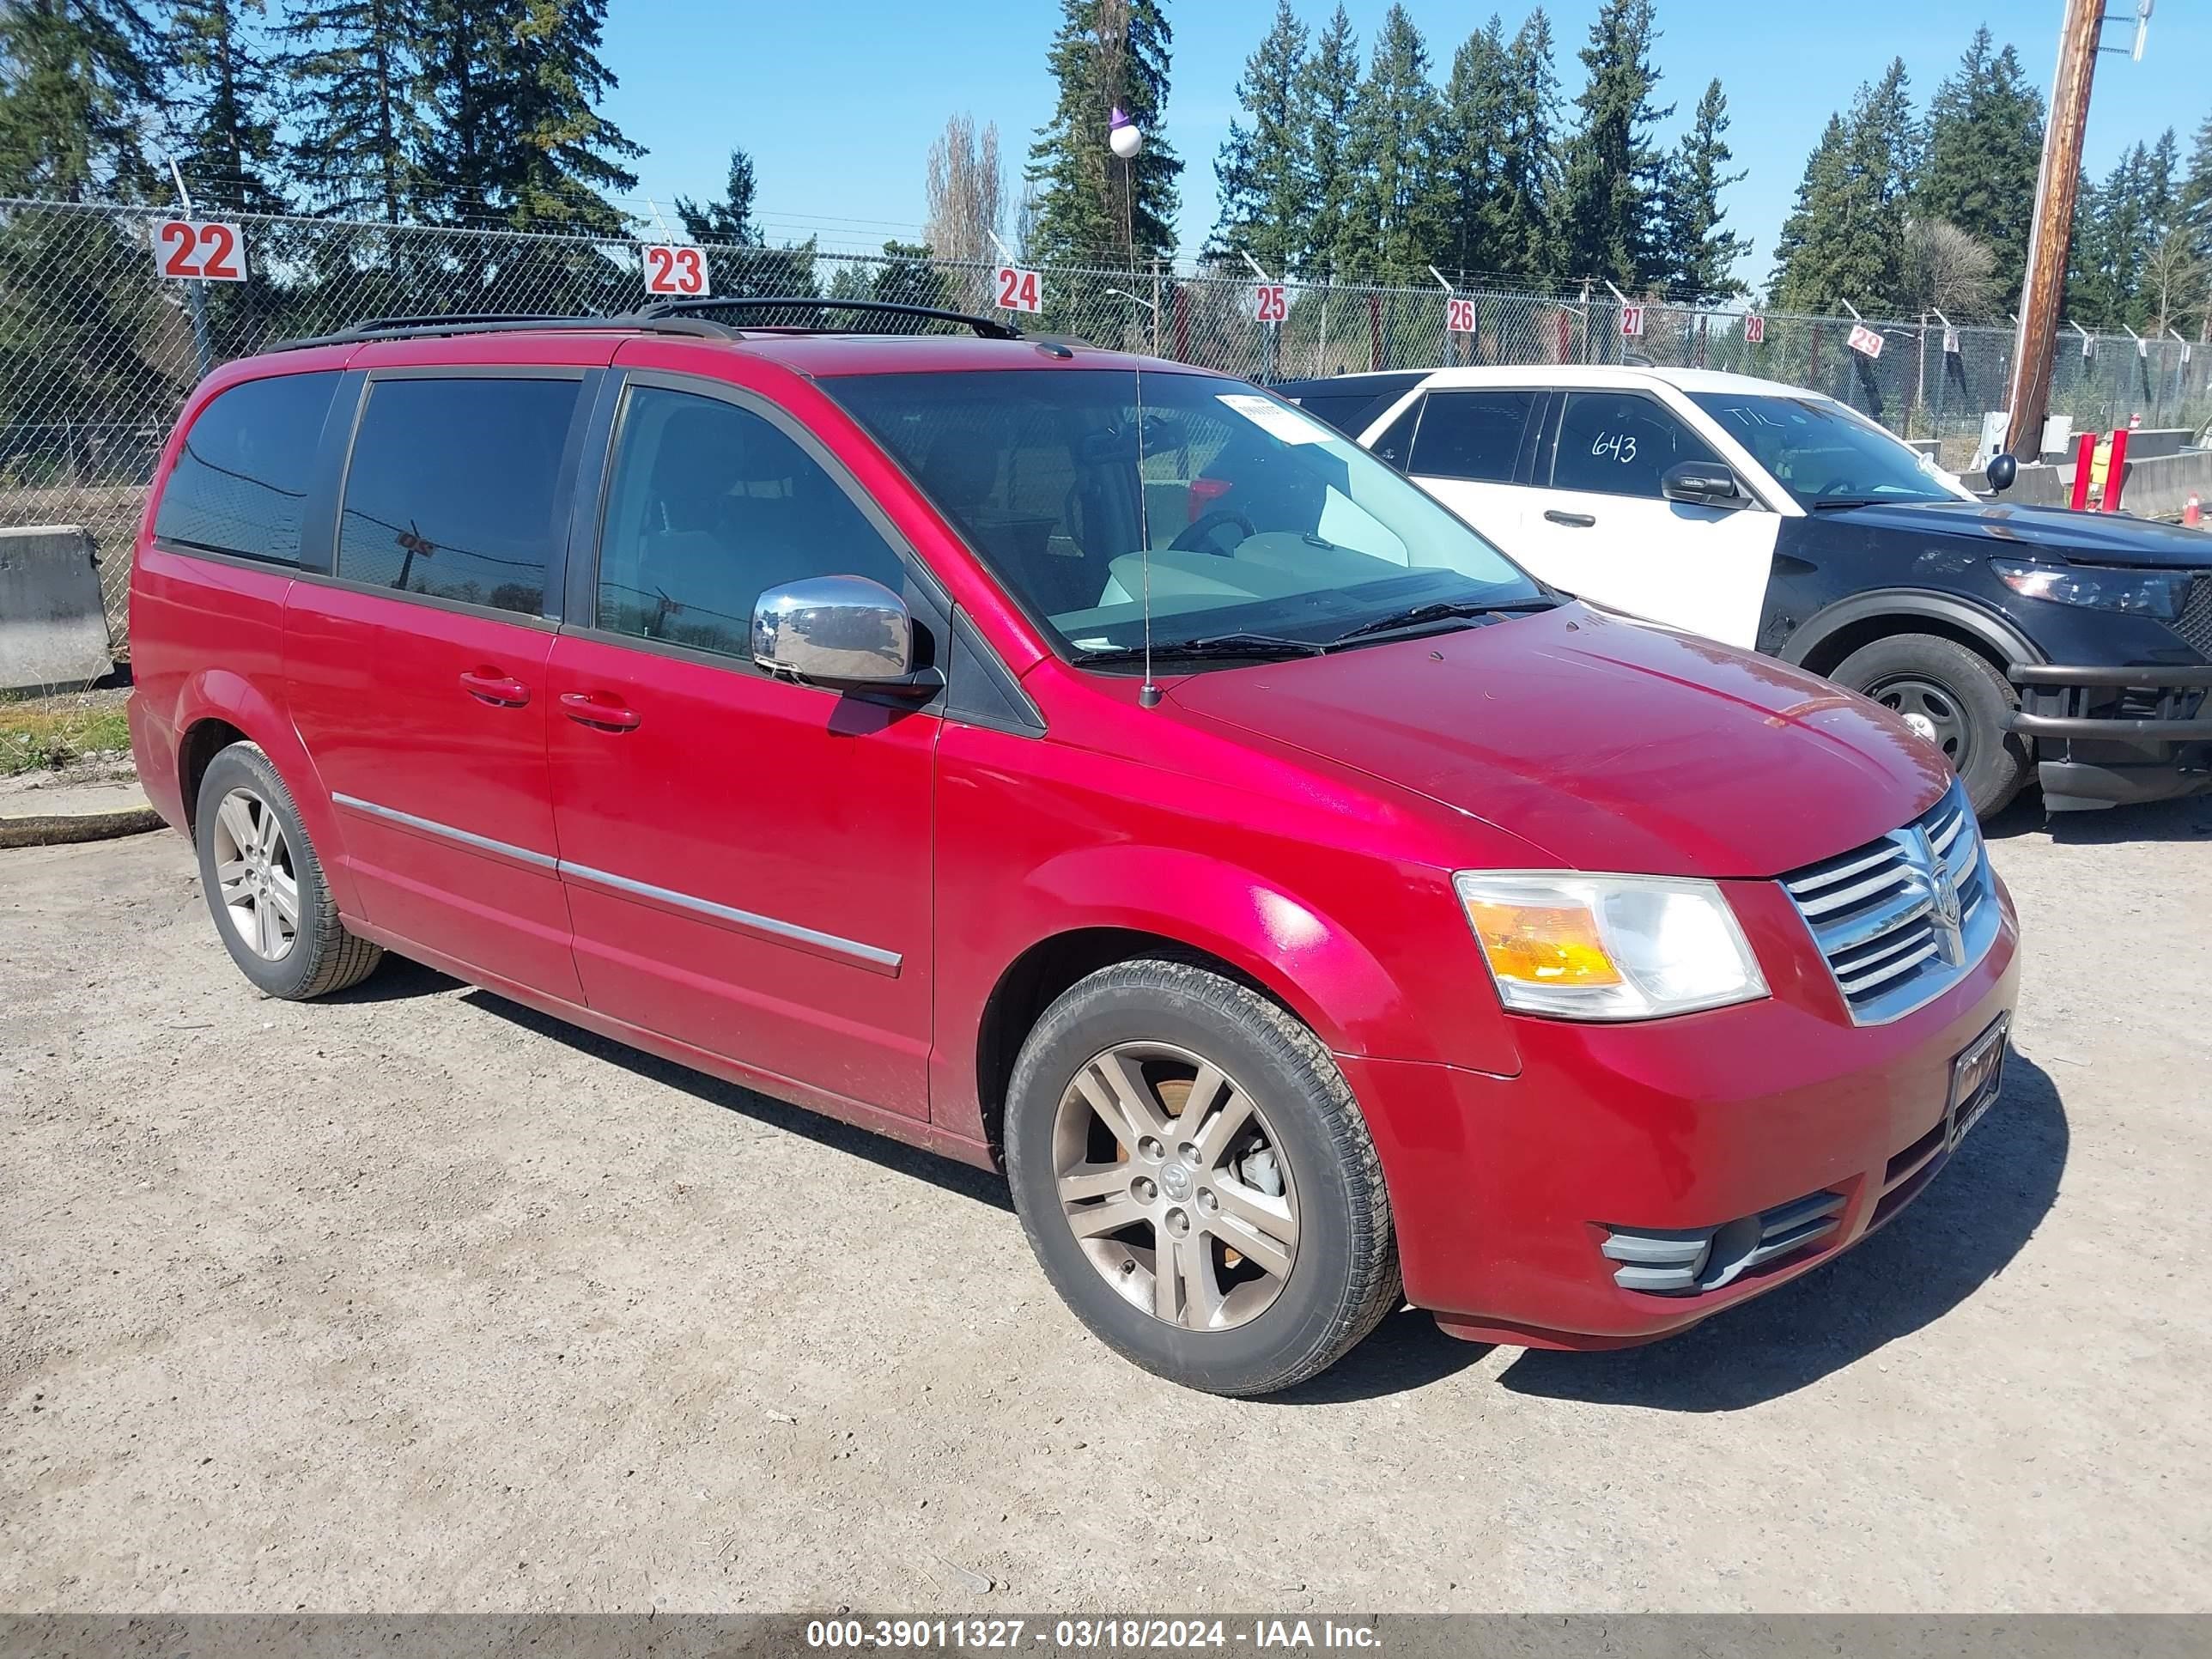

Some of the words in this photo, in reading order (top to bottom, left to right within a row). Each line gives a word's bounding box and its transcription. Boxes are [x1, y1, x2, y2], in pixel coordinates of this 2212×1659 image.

[161, 222, 238, 278] 22
[648, 247, 702, 294] 23
[1000, 269, 1037, 310] 24
[1258, 287, 1285, 320] 25
[1449, 301, 1473, 331] 26
[1623, 308, 1640, 334] 27
[1747, 317, 1762, 341] 28
[1852, 328, 1880, 354] 29
[1592, 431, 1637, 463] 643
